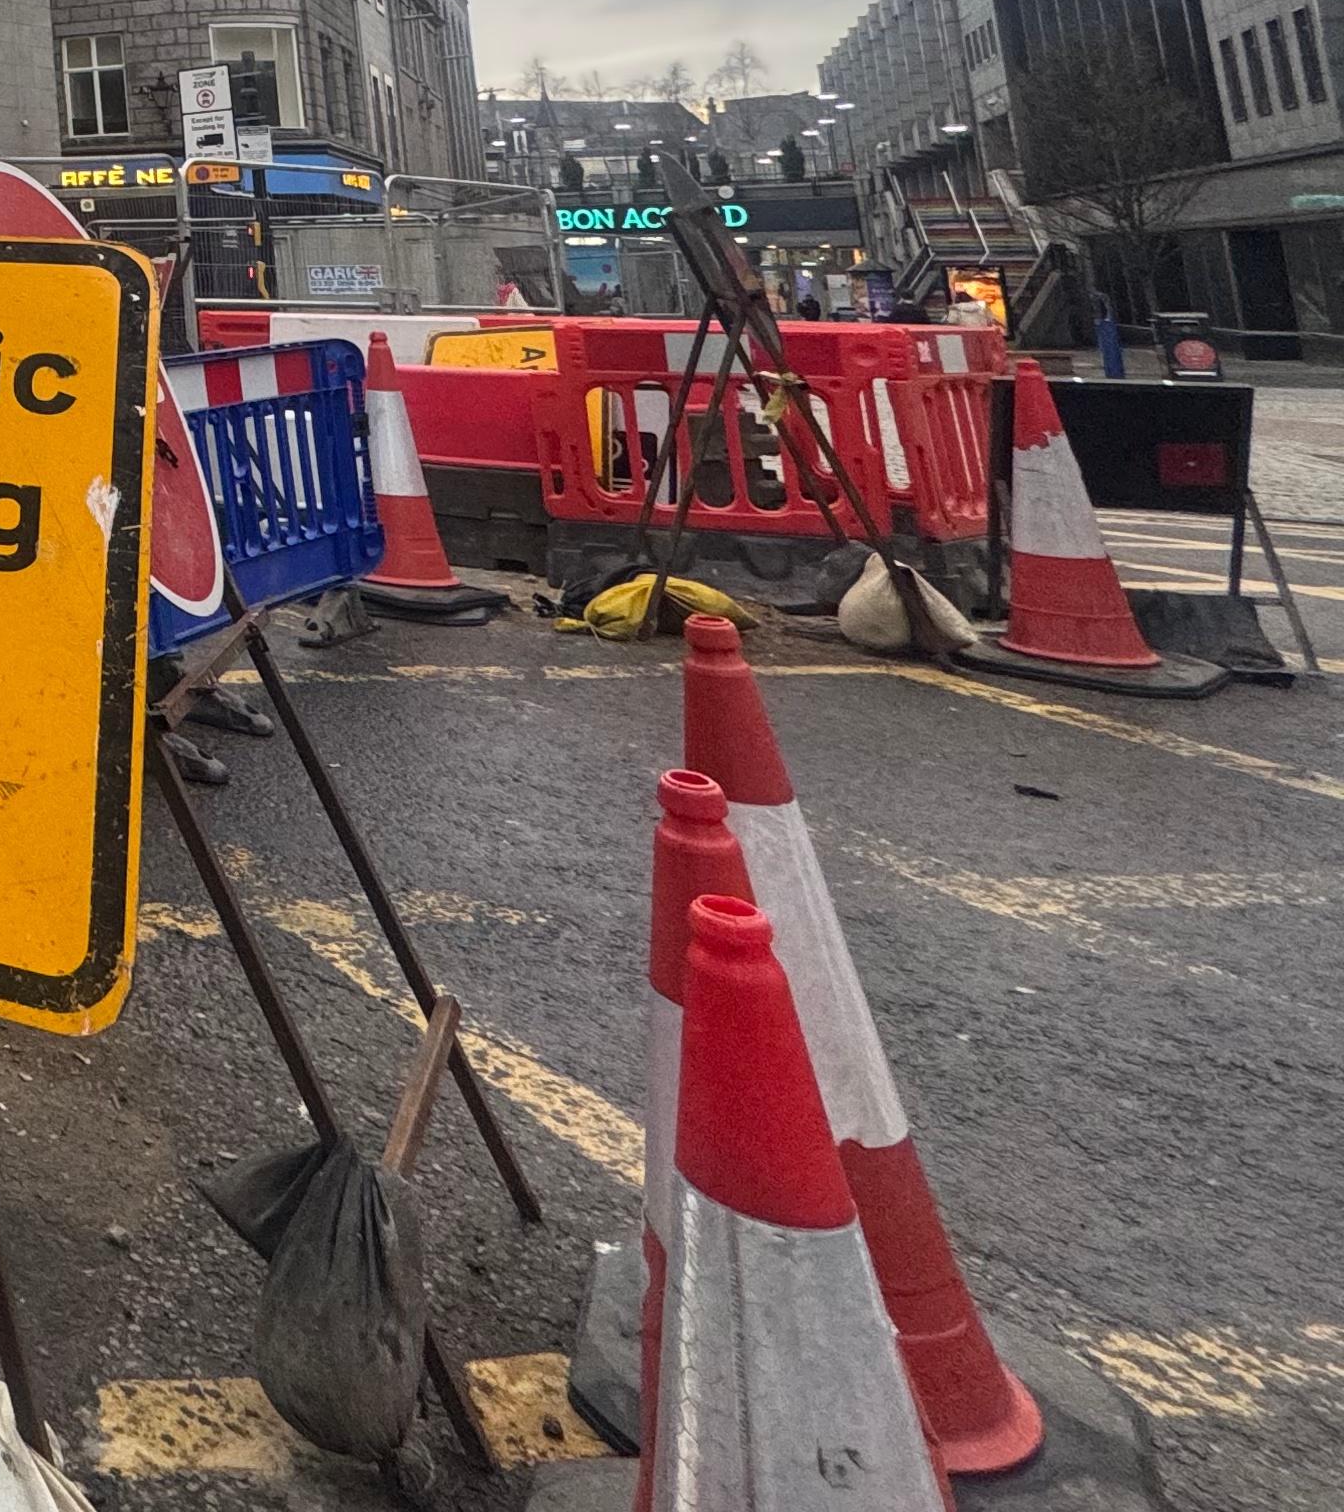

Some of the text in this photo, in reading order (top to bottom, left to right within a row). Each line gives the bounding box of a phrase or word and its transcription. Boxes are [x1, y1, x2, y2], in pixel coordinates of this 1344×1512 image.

[192, 79, 216, 89] ZONE
[61, 164, 175, 186] AFFÈ NE
[556, 208, 614, 230] BON
[310, 267, 362, 280] GARIC
